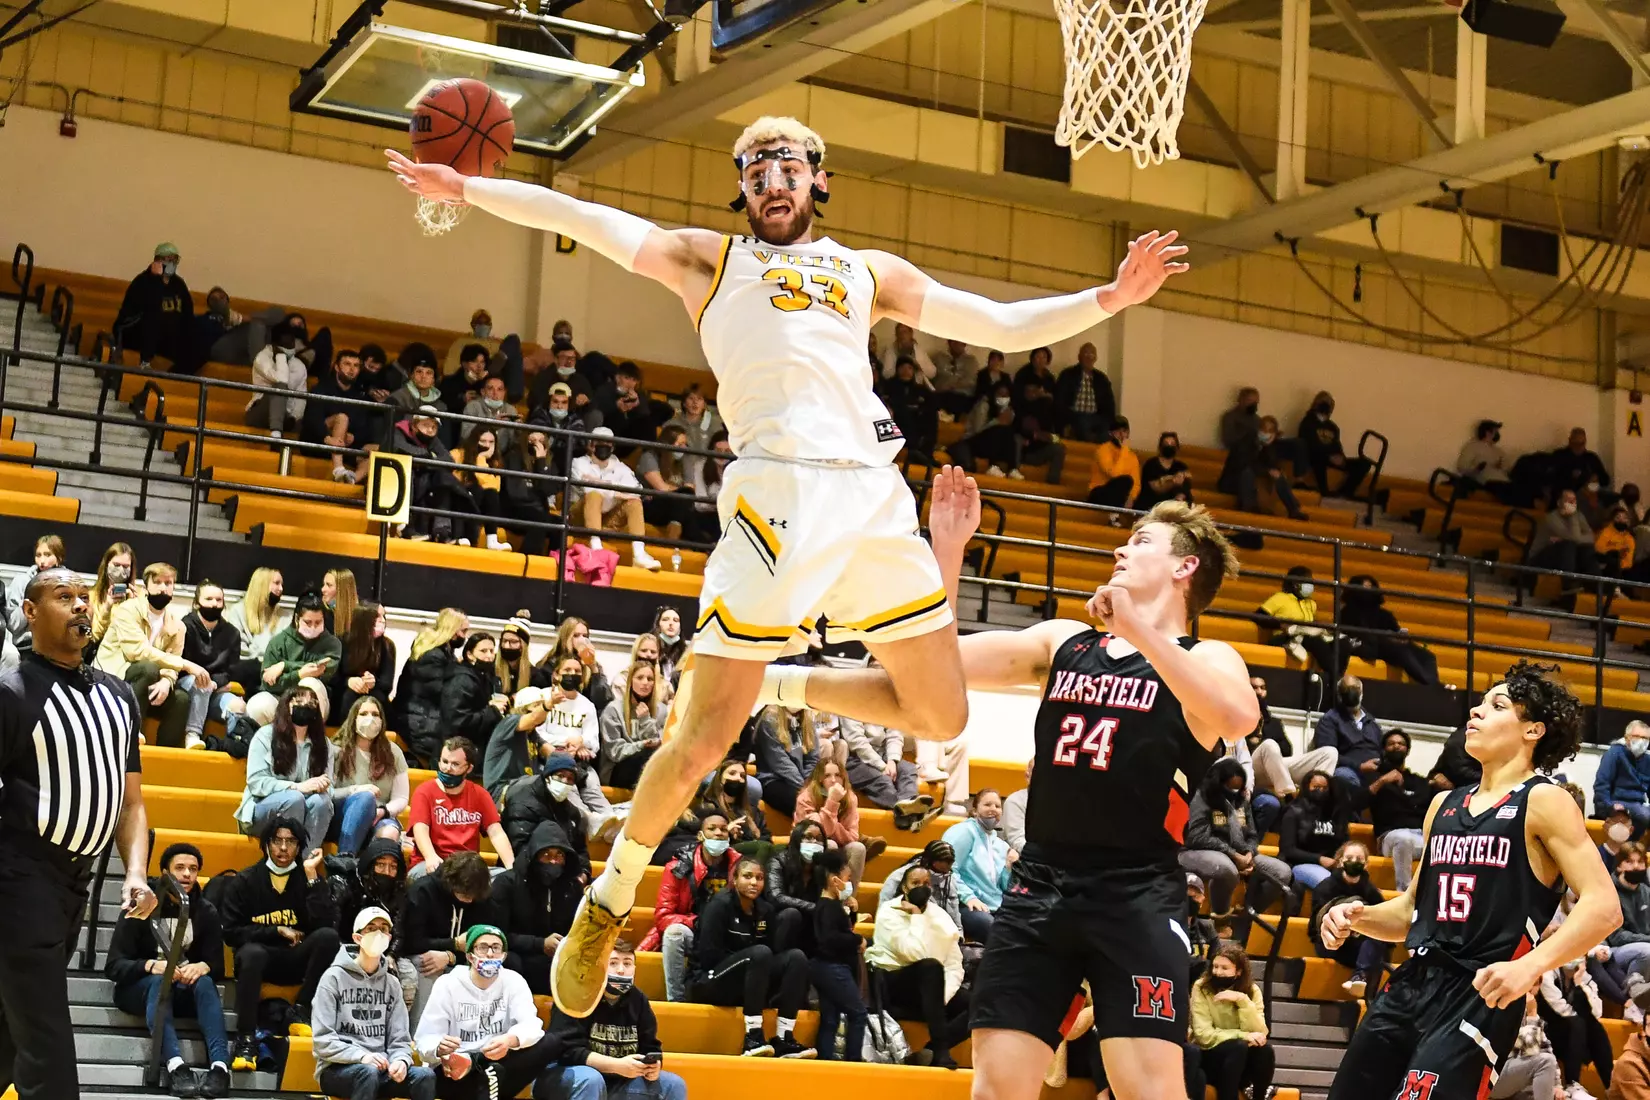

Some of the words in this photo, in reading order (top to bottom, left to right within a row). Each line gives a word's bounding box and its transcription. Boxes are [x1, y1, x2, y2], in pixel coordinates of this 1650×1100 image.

[762, 268, 850, 319] 33
[1626, 411, 1643, 438] A
[371, 456, 406, 516] D
[1053, 713, 1120, 771] 24
[1430, 834, 1511, 868] MANSFIELD
[1437, 873, 1477, 922] 15
[1132, 975, 1176, 1022] M
[1395, 1070, 1439, 1100] M
